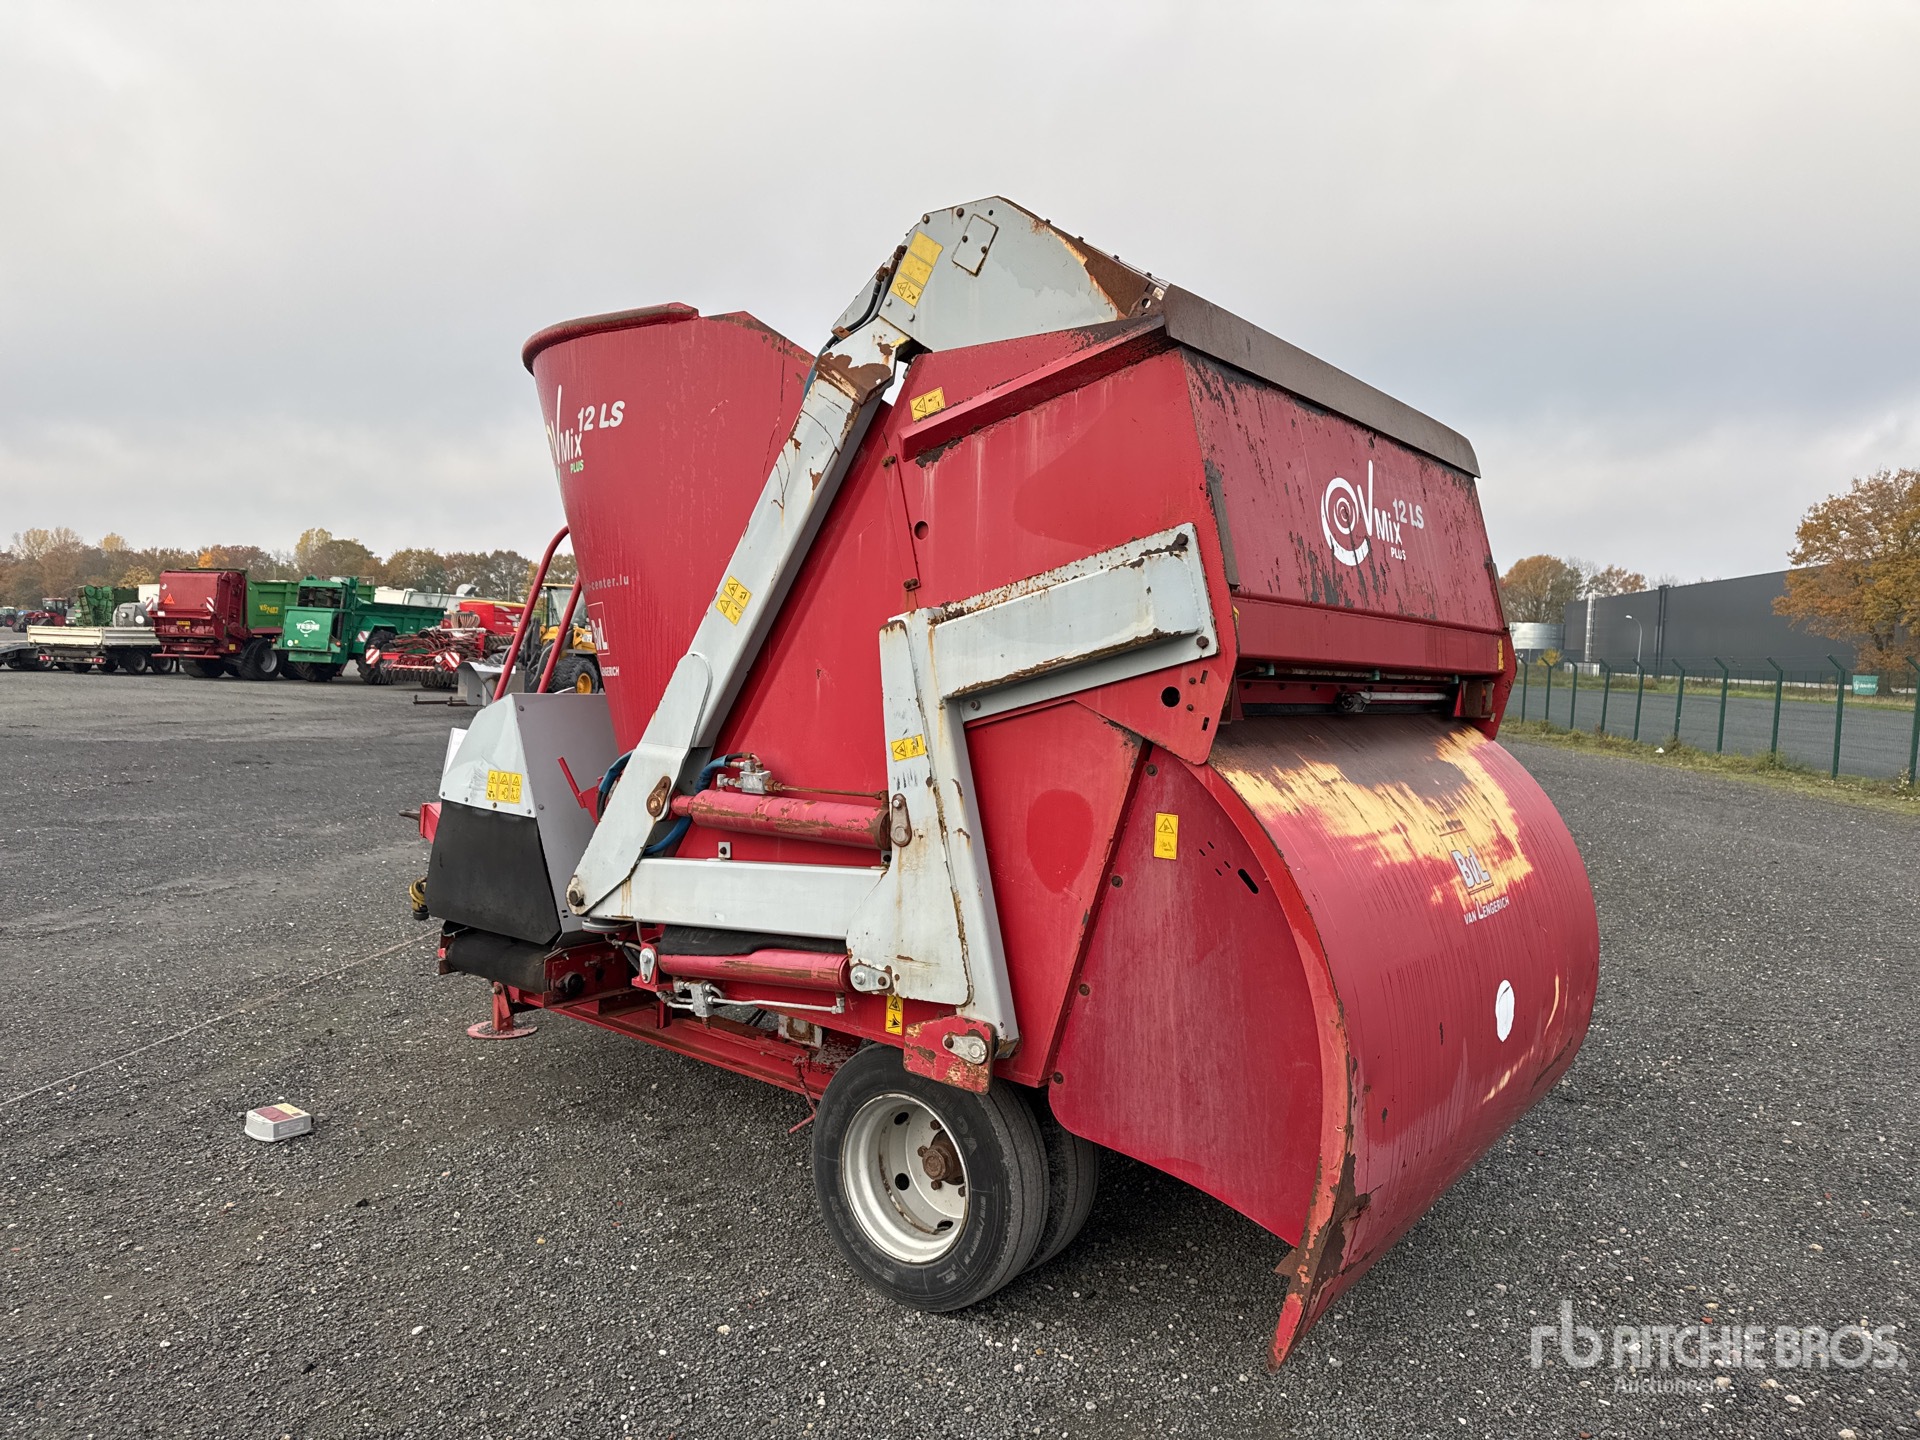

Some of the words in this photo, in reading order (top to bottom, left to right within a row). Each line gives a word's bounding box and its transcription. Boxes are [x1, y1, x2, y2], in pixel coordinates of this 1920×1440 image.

[577, 405, 596, 431] 12
[599, 400, 625, 428] LS
[570, 459, 584, 474] PLUS
[1392, 498, 1408, 524] 12
[1408, 501, 1425, 530] LS
[1390, 546, 1407, 561] PLUS
[582, 574, 629, 592] -center.lu
